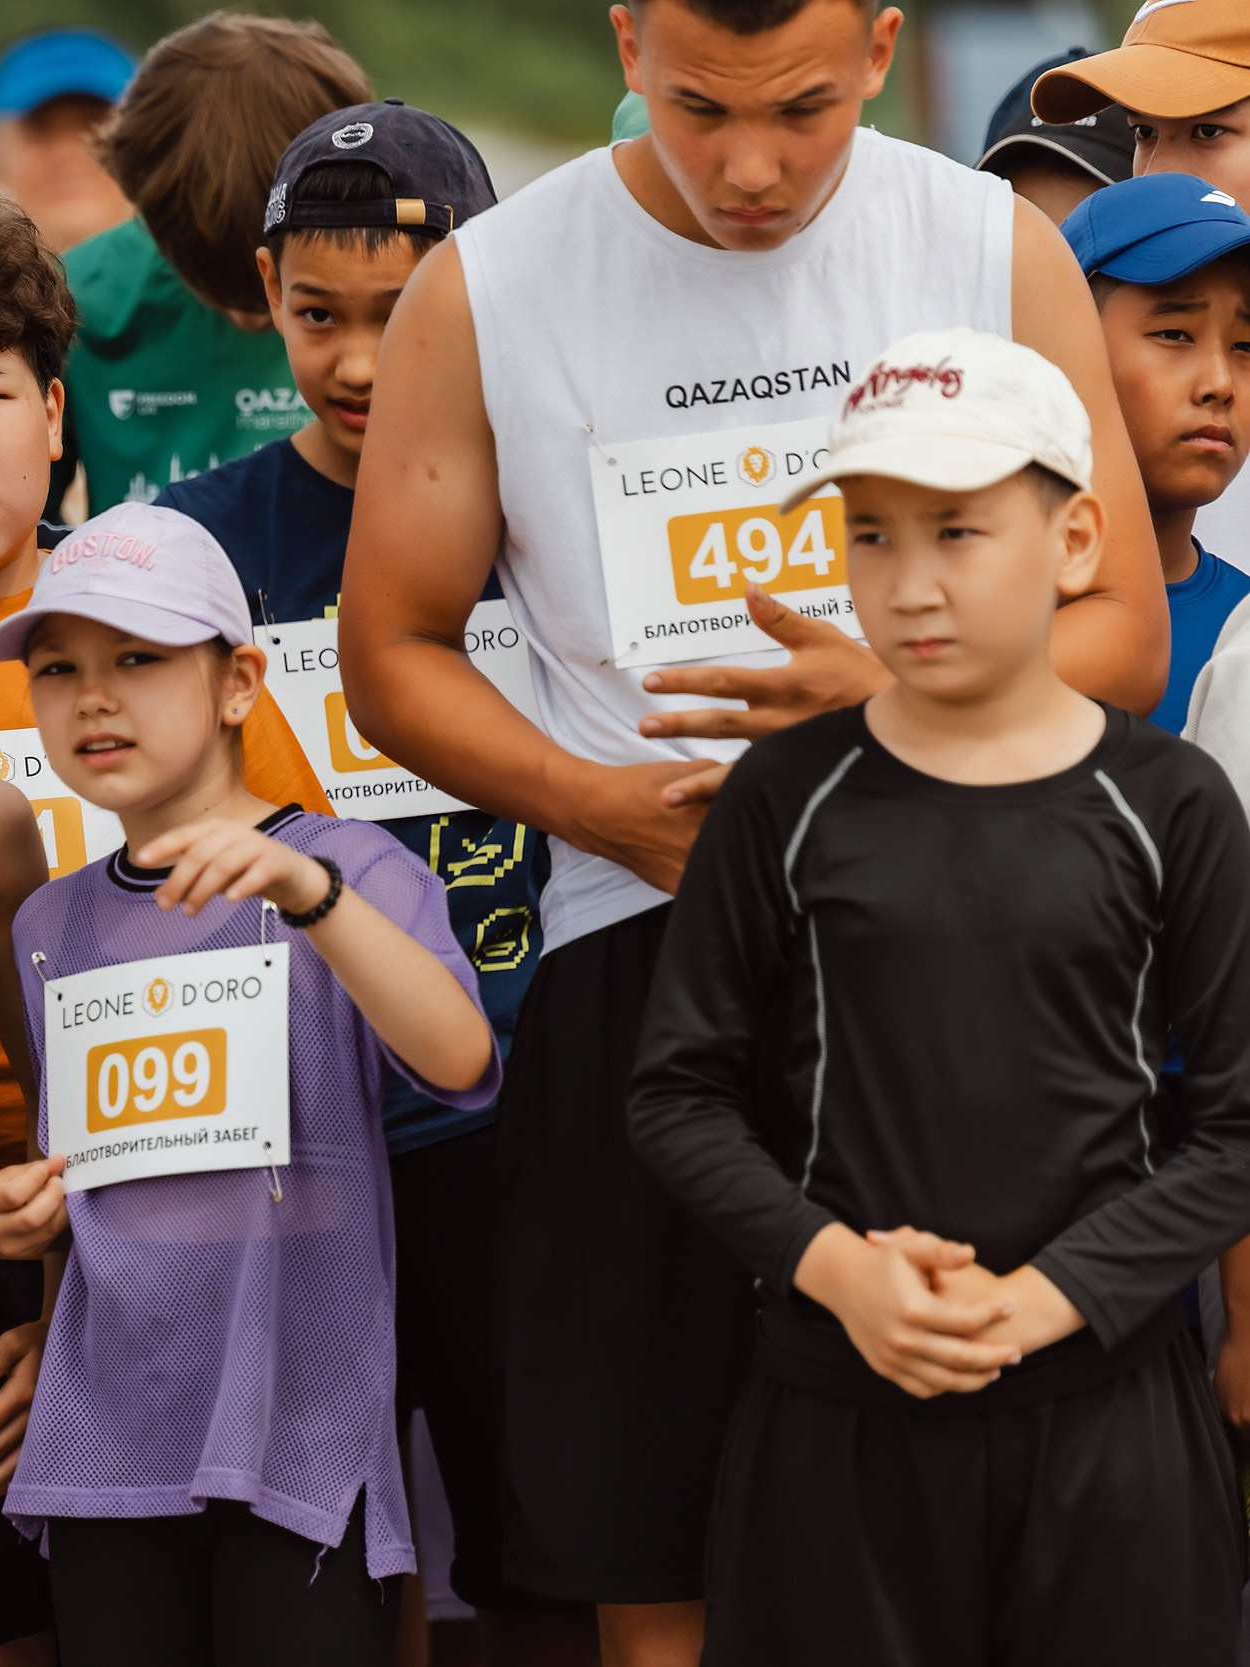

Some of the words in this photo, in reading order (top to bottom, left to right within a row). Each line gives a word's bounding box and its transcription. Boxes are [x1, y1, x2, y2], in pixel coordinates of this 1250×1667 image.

[235, 388, 310, 416] QAZA
[666, 360, 852, 408] QAZAQSTAN
[621, 462, 728, 496] LEONE
[689, 509, 835, 588] 494
[283, 648, 339, 673] LEO
[464, 627, 519, 653] ORO
[63, 992, 134, 1029] LEONE
[182, 976, 262, 1006] D'ORO
[98, 1041, 210, 1118] 099
[66, 1128, 208, 1169] БЛАГОТВОРИТЕЛЬНЫЙ
[213, 1127, 259, 1143] ЗАБЕГ
